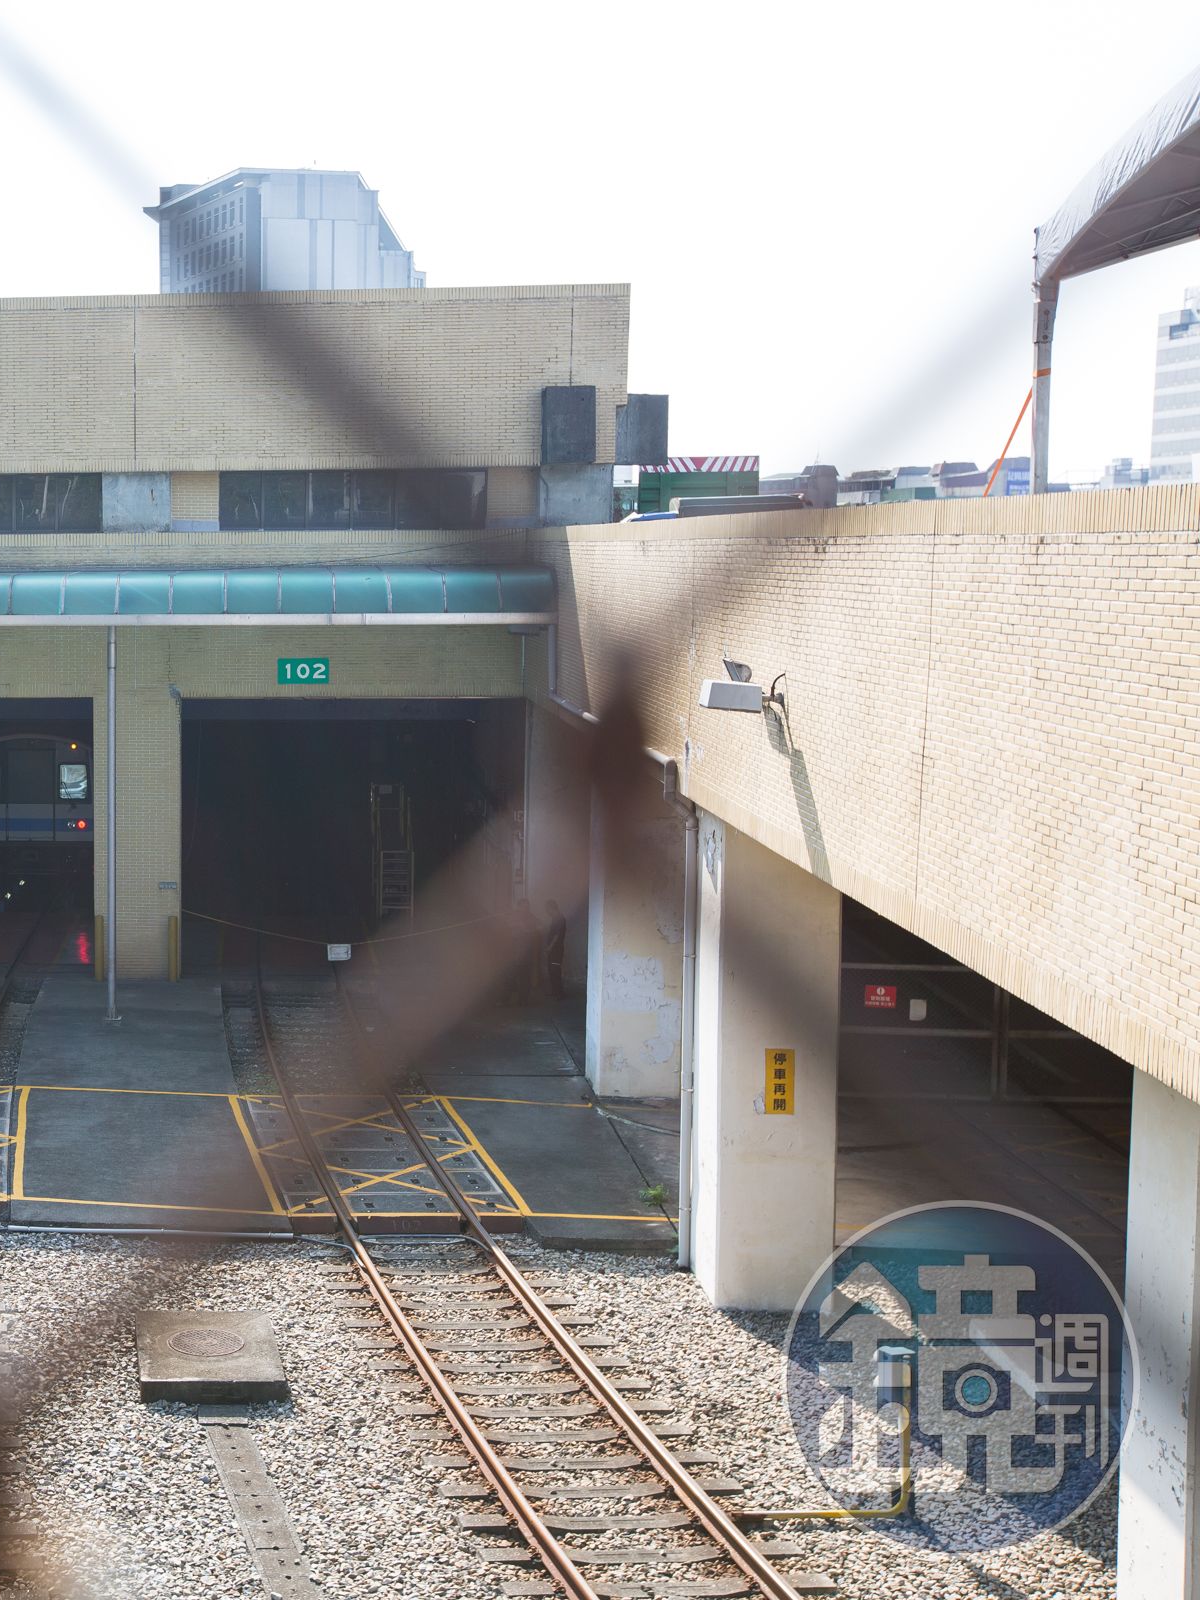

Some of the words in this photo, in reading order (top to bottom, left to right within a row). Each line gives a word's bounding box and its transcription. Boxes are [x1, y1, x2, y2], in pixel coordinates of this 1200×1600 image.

[285, 663, 326, 679] 102
[773, 1052, 787, 1111] 停車再開
